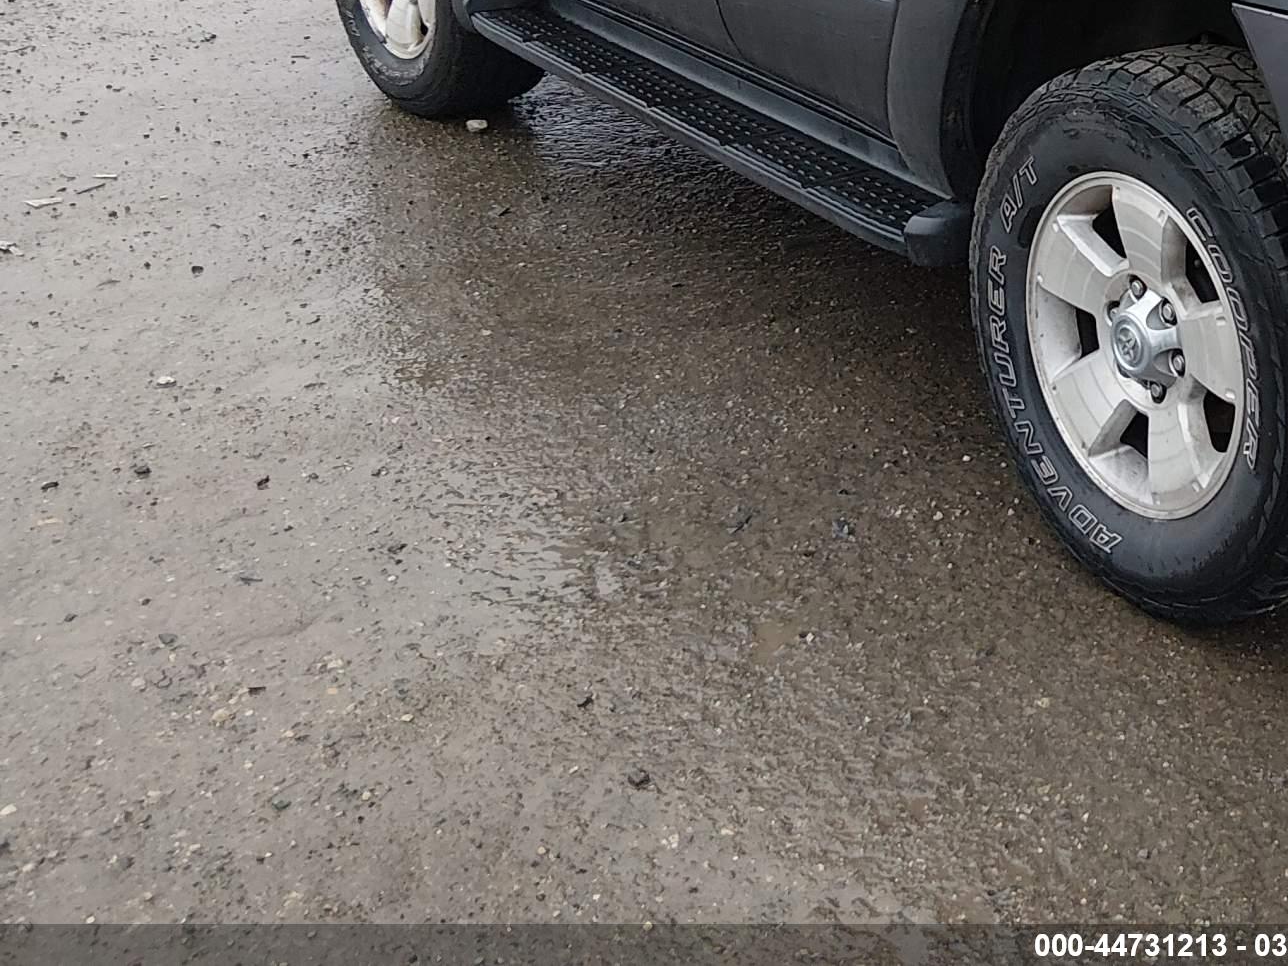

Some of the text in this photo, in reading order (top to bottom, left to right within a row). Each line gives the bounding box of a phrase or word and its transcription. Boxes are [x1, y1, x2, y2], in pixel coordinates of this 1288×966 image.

[987, 155, 1123, 555] ADVENTURER A/T
[1185, 206, 1265, 470] COOPER
